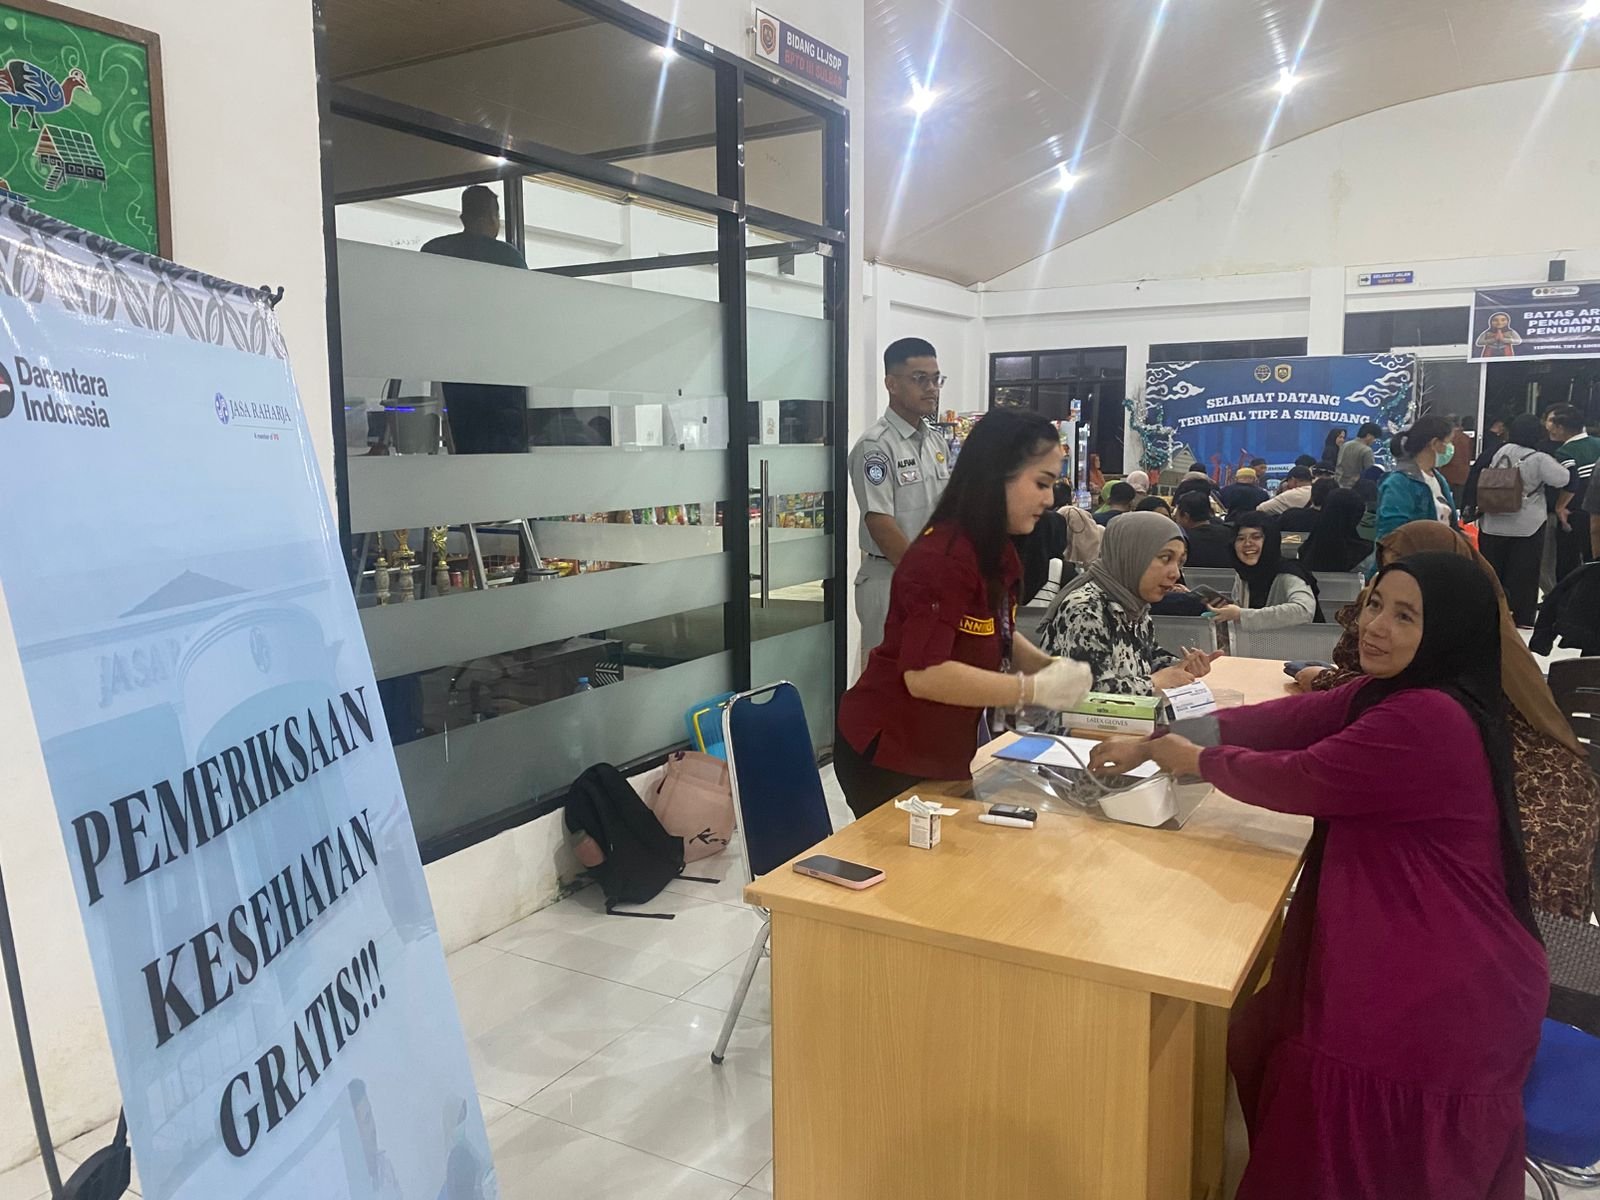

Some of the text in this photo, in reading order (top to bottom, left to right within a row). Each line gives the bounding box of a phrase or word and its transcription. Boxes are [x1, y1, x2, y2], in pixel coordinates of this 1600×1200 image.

[786, 31, 815, 58] BIDANG
[1523, 310, 1575, 319] BATAS
[1528, 317, 1600, 327] PENGANT
[1526, 325, 1600, 336] PENUMPA
[21, 390, 110, 429] Indonesia
[229, 399, 292, 424] JASA RAHARJA
[1206, 392, 1340, 409] SELAMAT DATANG
[1177, 410, 1370, 428] TERMINAL TIPE A SIMBUANG
[71, 686, 375, 906] PEMERIKSAAN
[141, 808, 380, 1049] KESEHATAN
[219, 939, 387, 1158] GRATIS!!!
